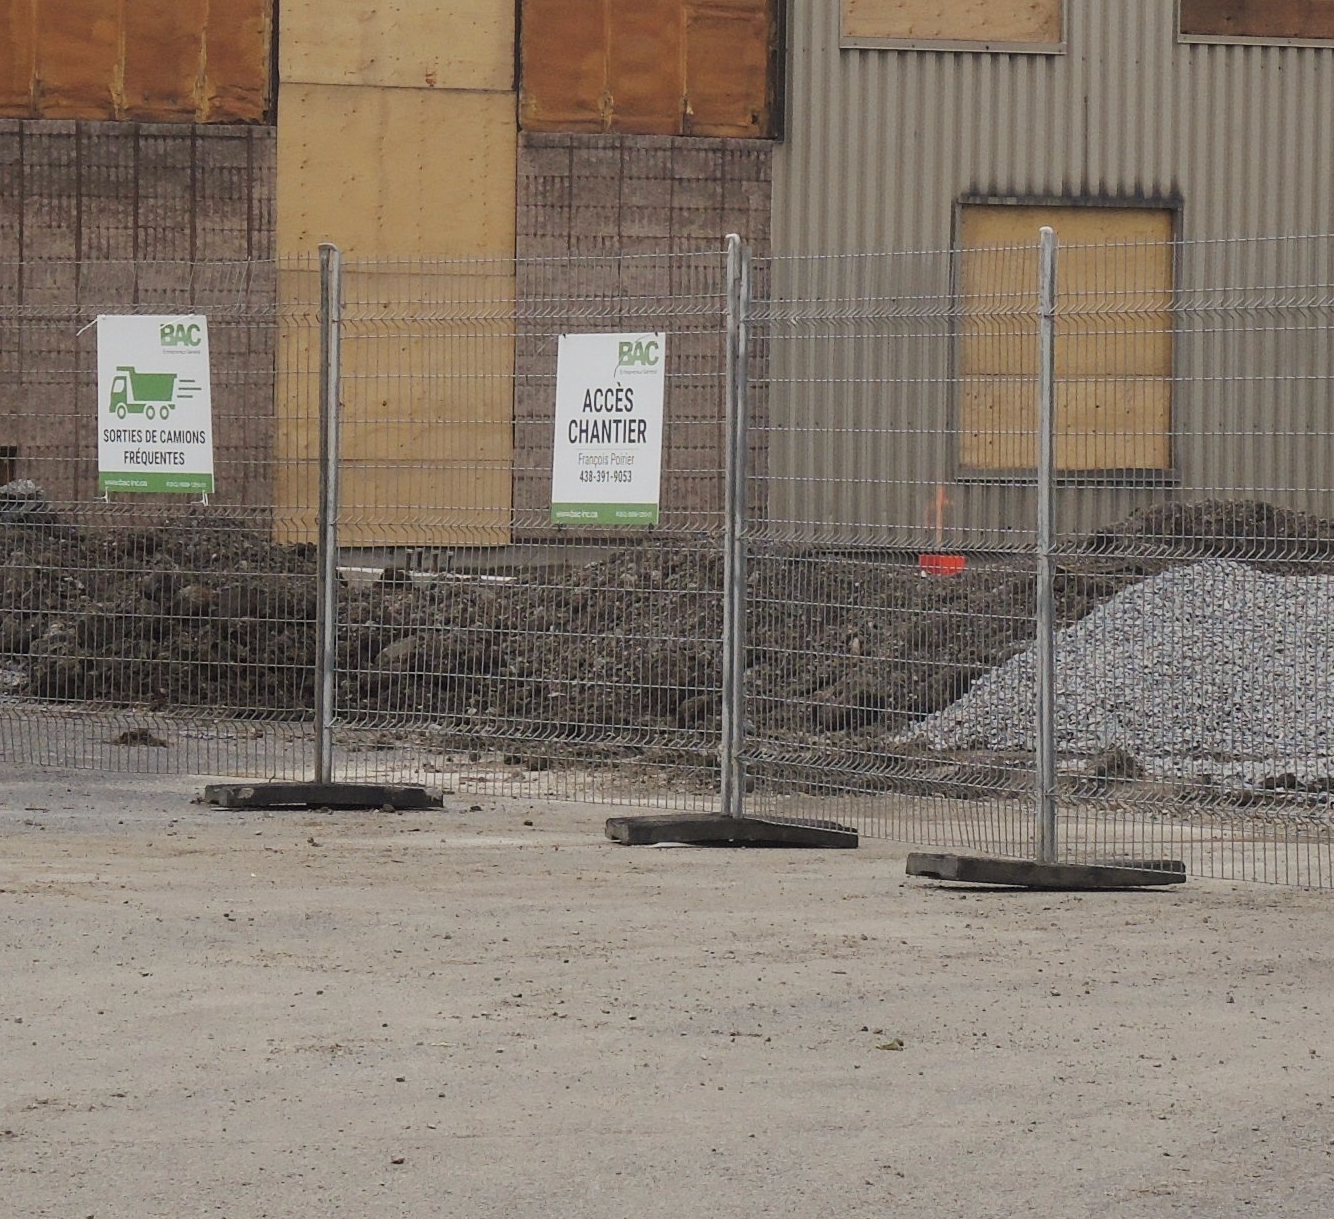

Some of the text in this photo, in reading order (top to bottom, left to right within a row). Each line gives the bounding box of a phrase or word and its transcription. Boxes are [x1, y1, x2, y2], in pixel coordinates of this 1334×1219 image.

[160, 323, 202, 347] BAC
[619, 340, 659, 366] BAC
[582, 381, 634, 413] ACCÈS
[103, 428, 206, 445] SORTIES DE CAMIONS
[568, 419, 647, 444] CHANTIER
[123, 448, 185, 466] FRÉQUENTES
[578, 452, 635, 468] François Poirier
